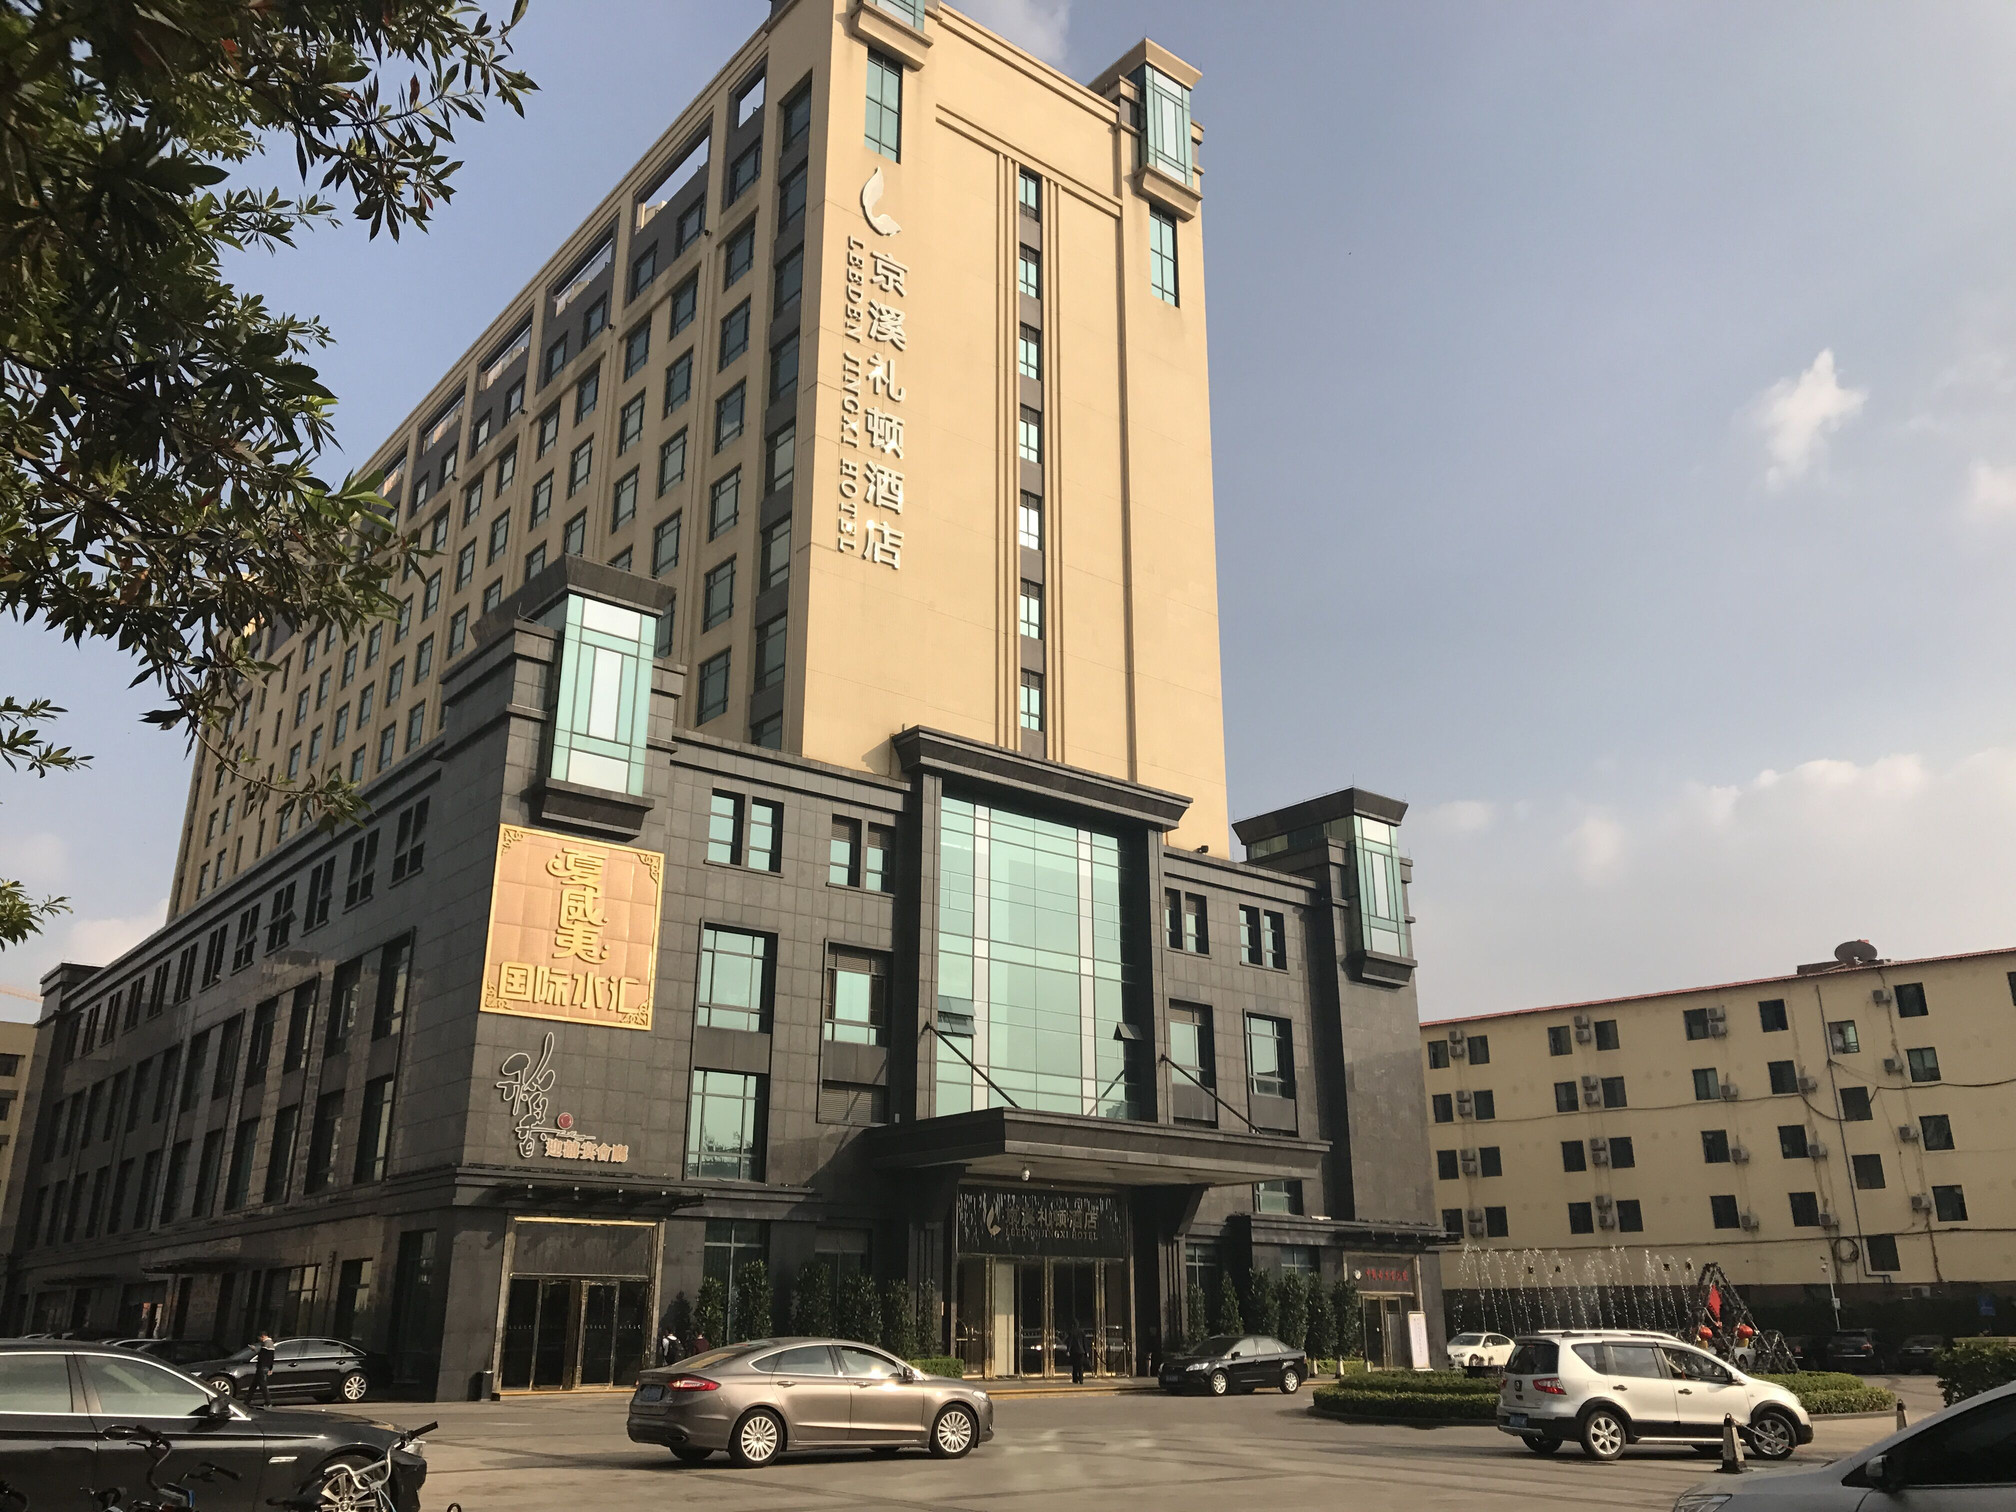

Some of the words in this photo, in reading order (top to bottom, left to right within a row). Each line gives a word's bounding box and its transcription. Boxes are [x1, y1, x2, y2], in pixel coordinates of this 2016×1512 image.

[844, 234, 864, 342] LEEDEN
[839, 350, 861, 449] JINGXI
[863, 250, 910, 570] 京溪礼顿酒店
[837, 457, 858, 553] HOTEL
[546, 847, 610, 965] 夏威夷
[498, 960, 642, 1015] 国际水汇
